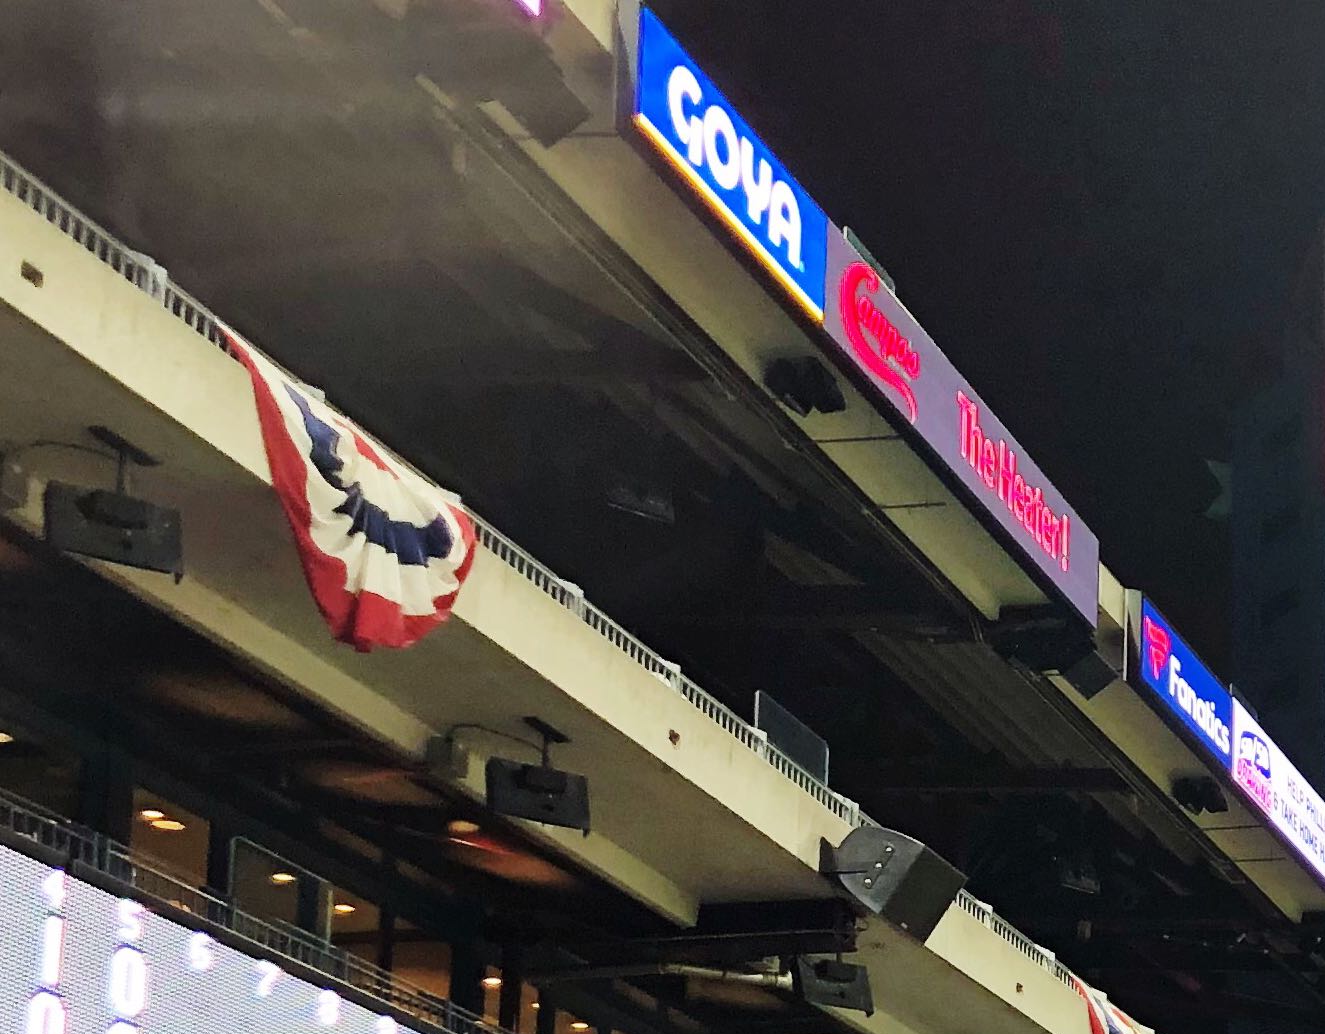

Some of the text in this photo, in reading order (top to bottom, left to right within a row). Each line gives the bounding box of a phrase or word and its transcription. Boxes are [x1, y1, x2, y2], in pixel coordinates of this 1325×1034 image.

[667, 65, 804, 270] GOYA
[957, 390, 1070, 571] The Heater!
[1168, 654, 1230, 755] Fanatics
